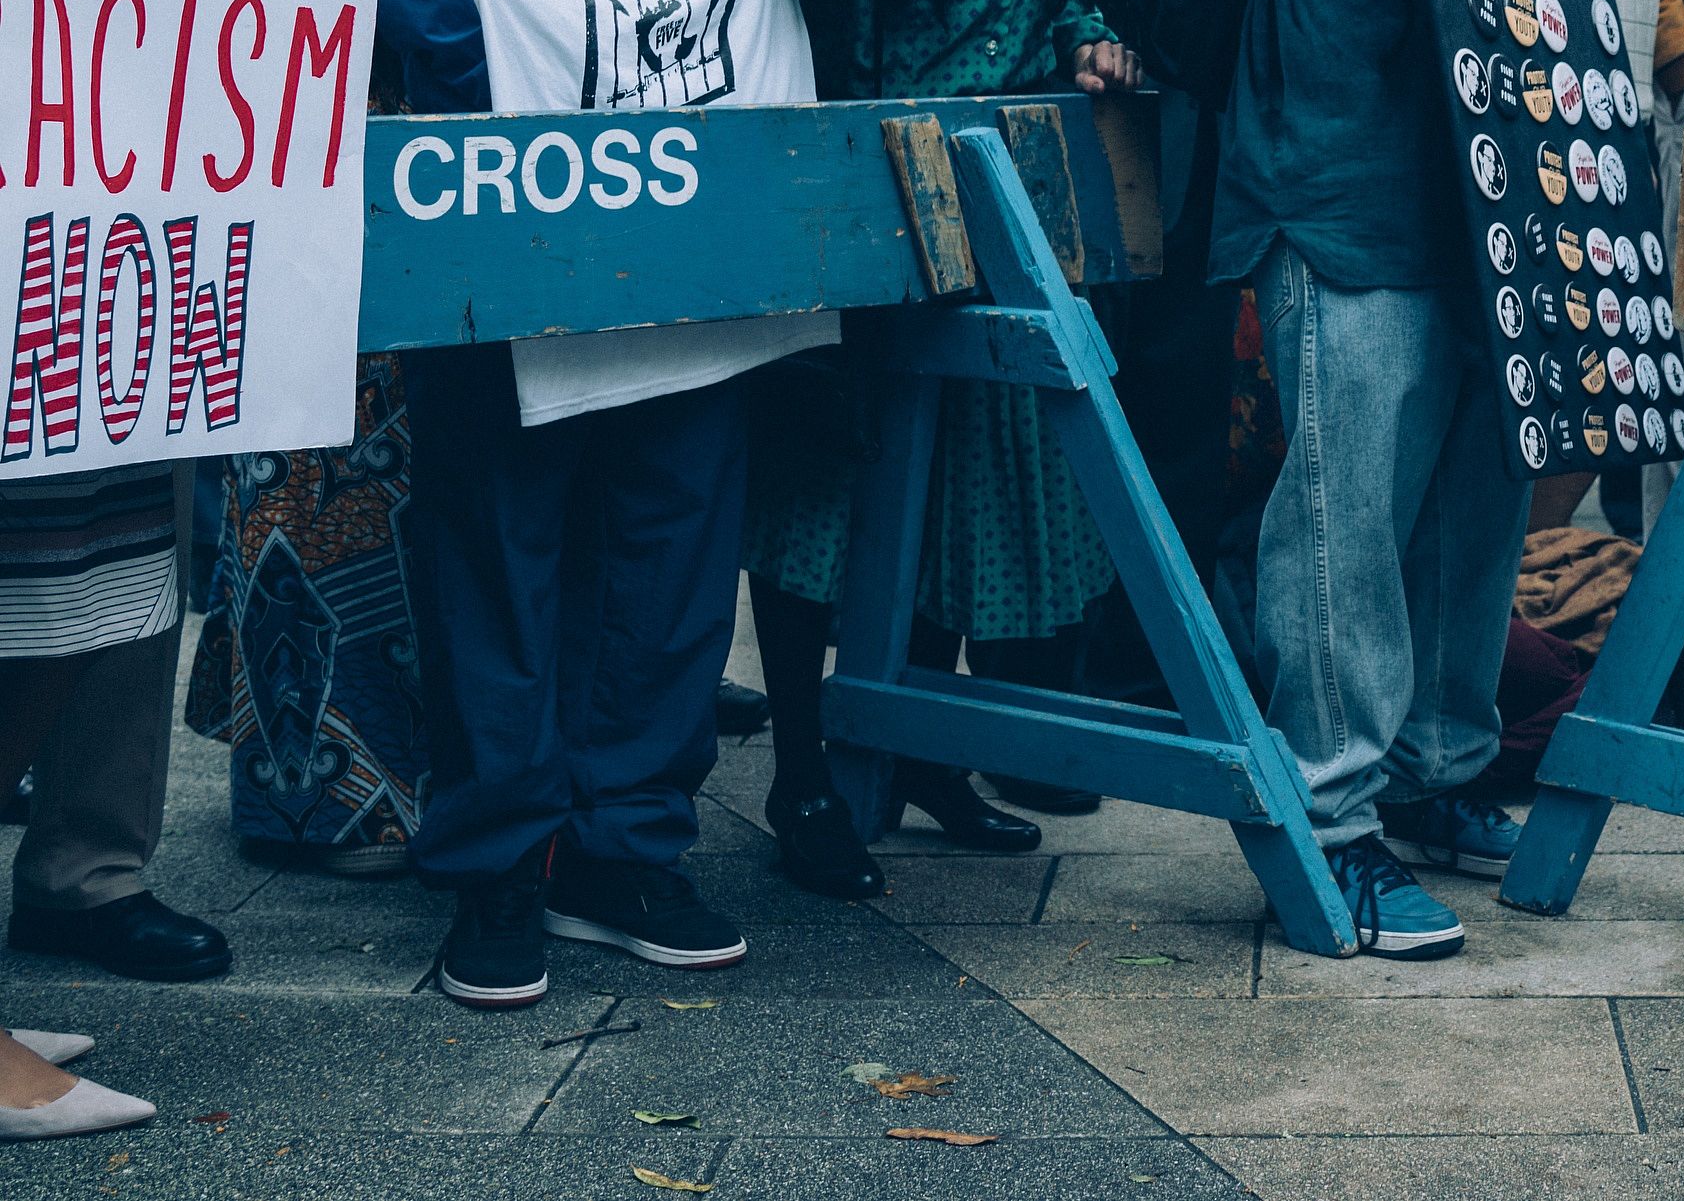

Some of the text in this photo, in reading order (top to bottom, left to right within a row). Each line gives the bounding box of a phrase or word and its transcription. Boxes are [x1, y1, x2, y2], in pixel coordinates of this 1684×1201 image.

[655, 26, 680, 50] FIVE
[656, 20, 674, 35] FREE
[1541, 10, 1568, 42] POWER
[1560, 83, 1583, 115] POWER
[393, 127, 699, 221] CROSS
[1576, 167, 1598, 185] POWER
[1591, 246, 1614, 265] POWER
[1602, 309, 1620, 324] POWER
[1, 211, 255, 463] NOW
